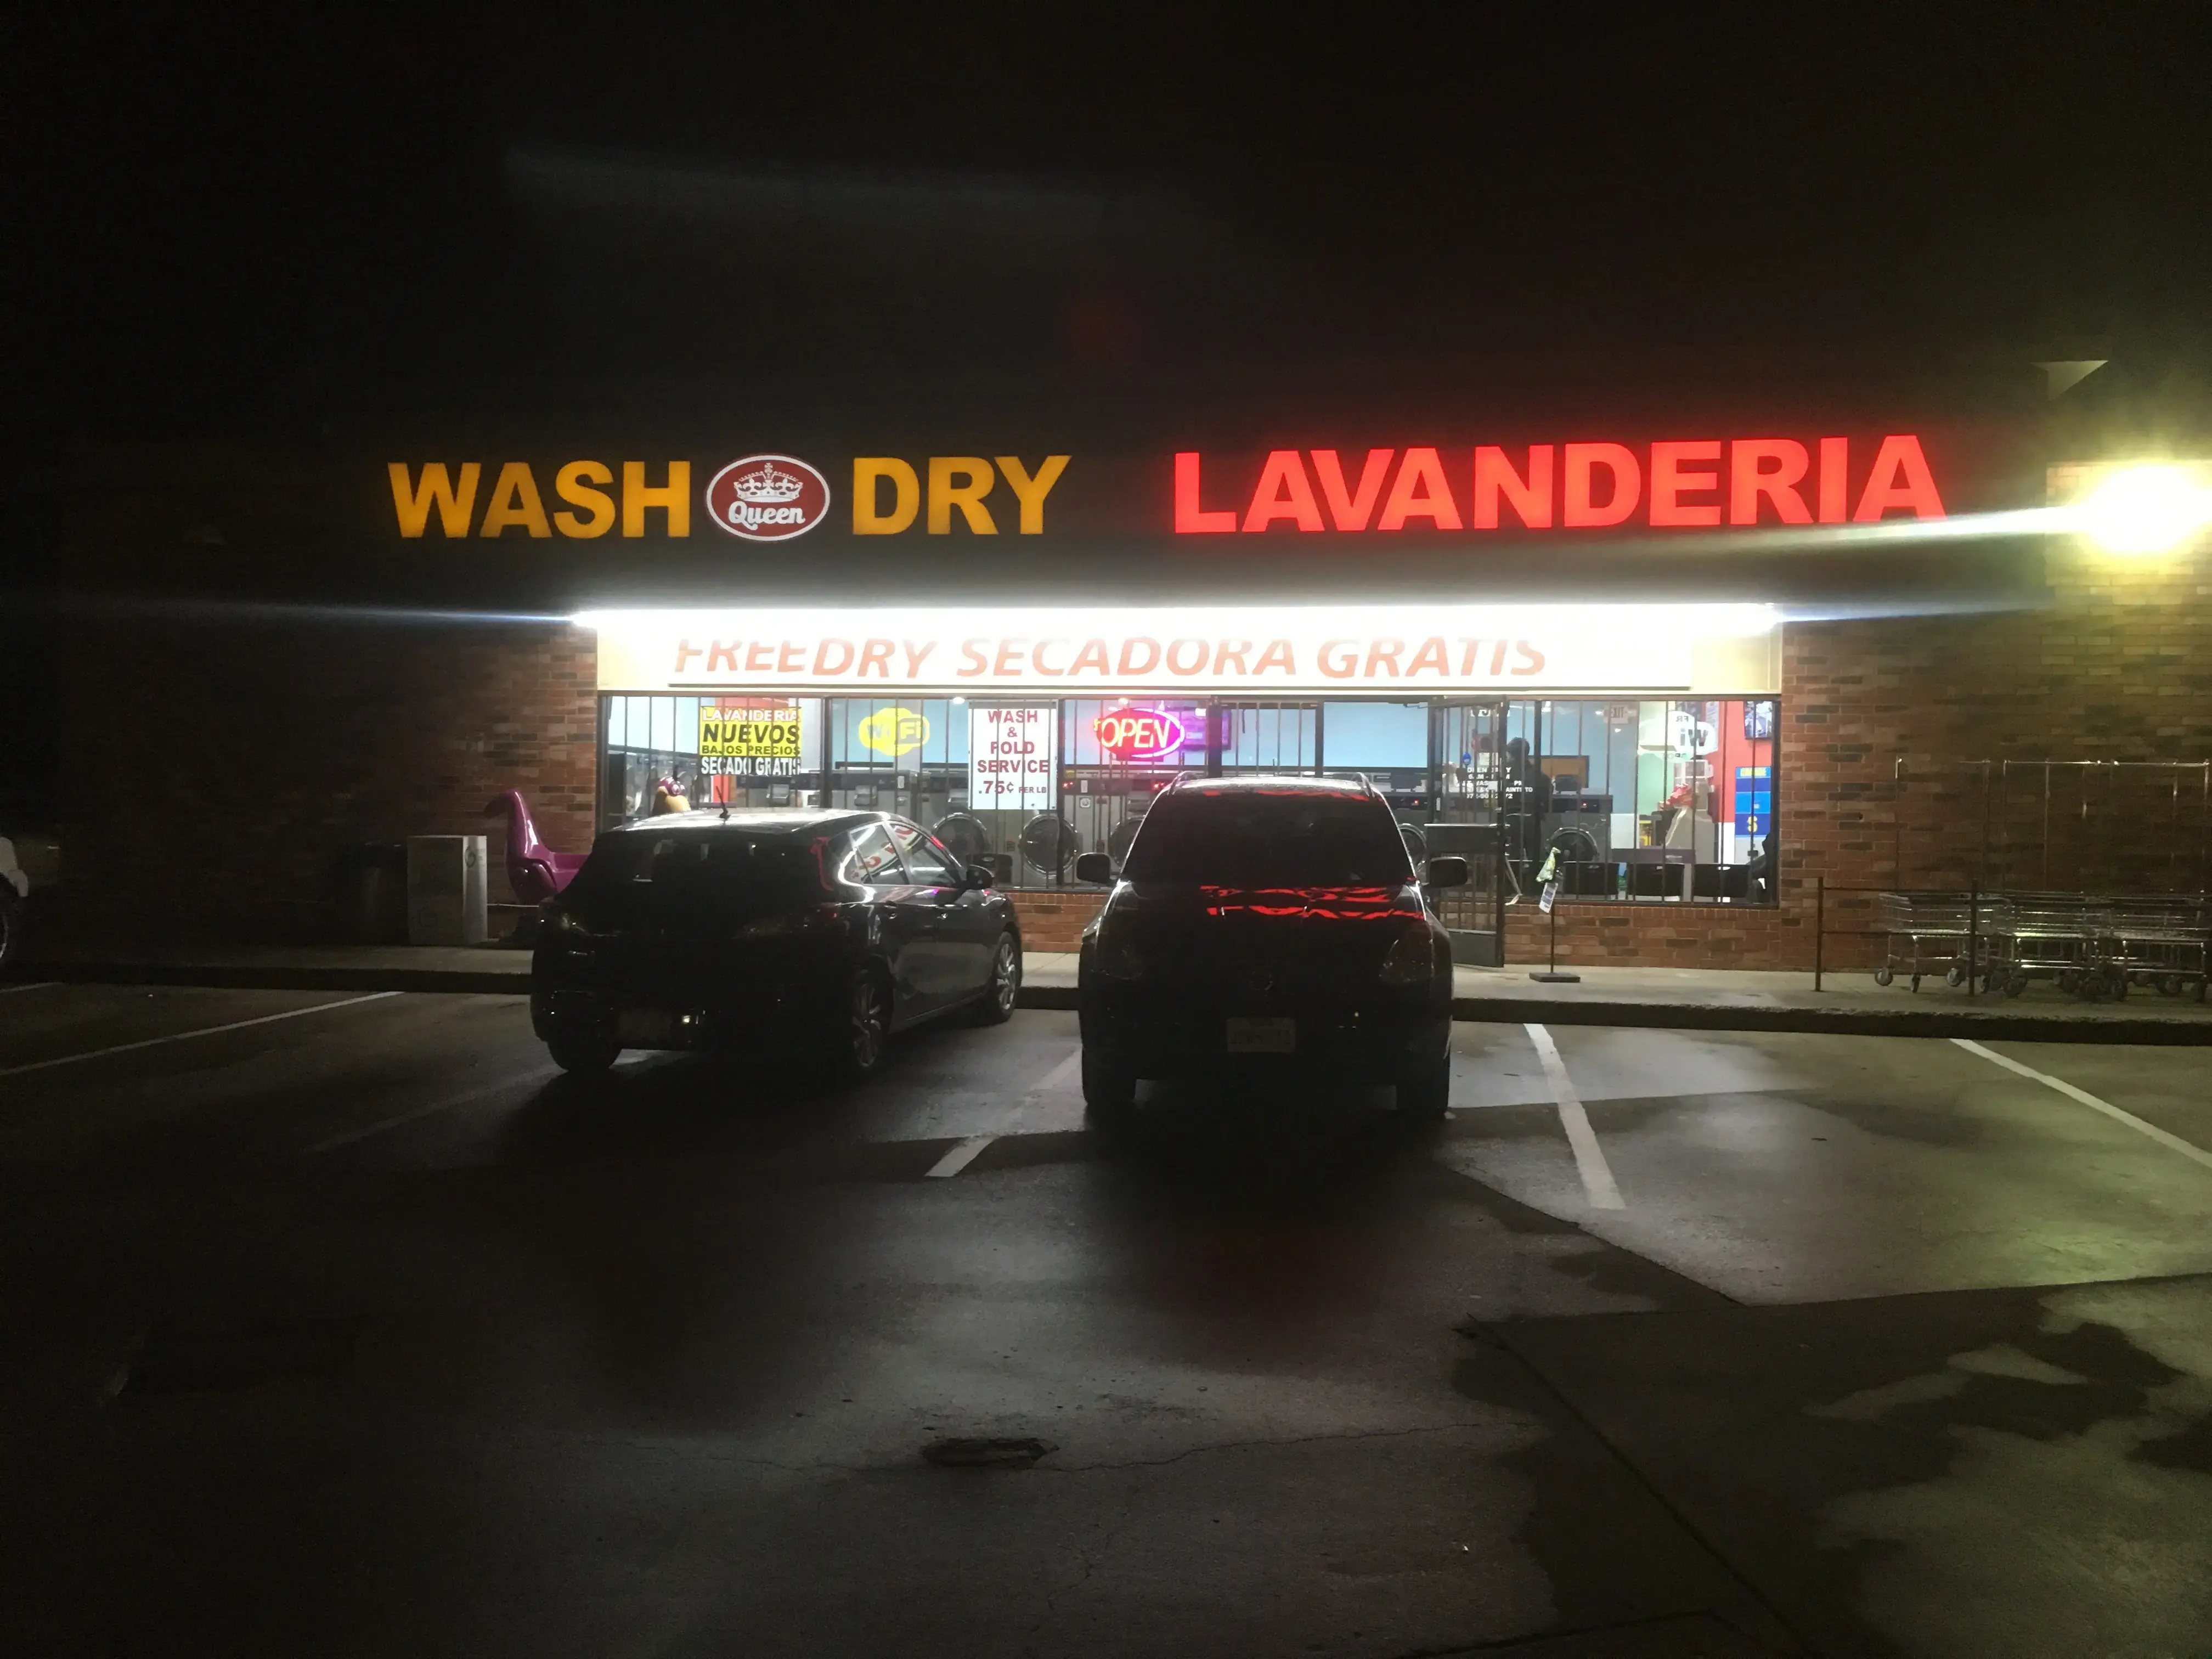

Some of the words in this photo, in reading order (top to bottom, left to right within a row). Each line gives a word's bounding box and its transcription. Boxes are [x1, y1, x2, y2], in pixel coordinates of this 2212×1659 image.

[1175, 435, 1947, 534] LAVANDERIA
[388, 460, 690, 538] WASH
[852, 455, 1072, 535] DRY
[728, 500, 806, 531] Queen
[956, 636, 1297, 677] SECADORA
[1317, 636, 1546, 678] GRATIS
[703, 708, 800, 721] LAVANDERIA
[988, 710, 1038, 723] WASH
[703, 724, 799, 744] NUEVOS
[1007, 726, 1018, 737] &
[1101, 717, 1171, 748] OPEN
[702, 745, 743, 754] BAJOS
[748, 746, 801, 755] PRECIOS
[990, 741, 1035, 754] FOLD
[701, 757, 752, 775] SECADO
[755, 757, 801, 776] GRATIS
[977, 760, 1049, 773] SERVICE
